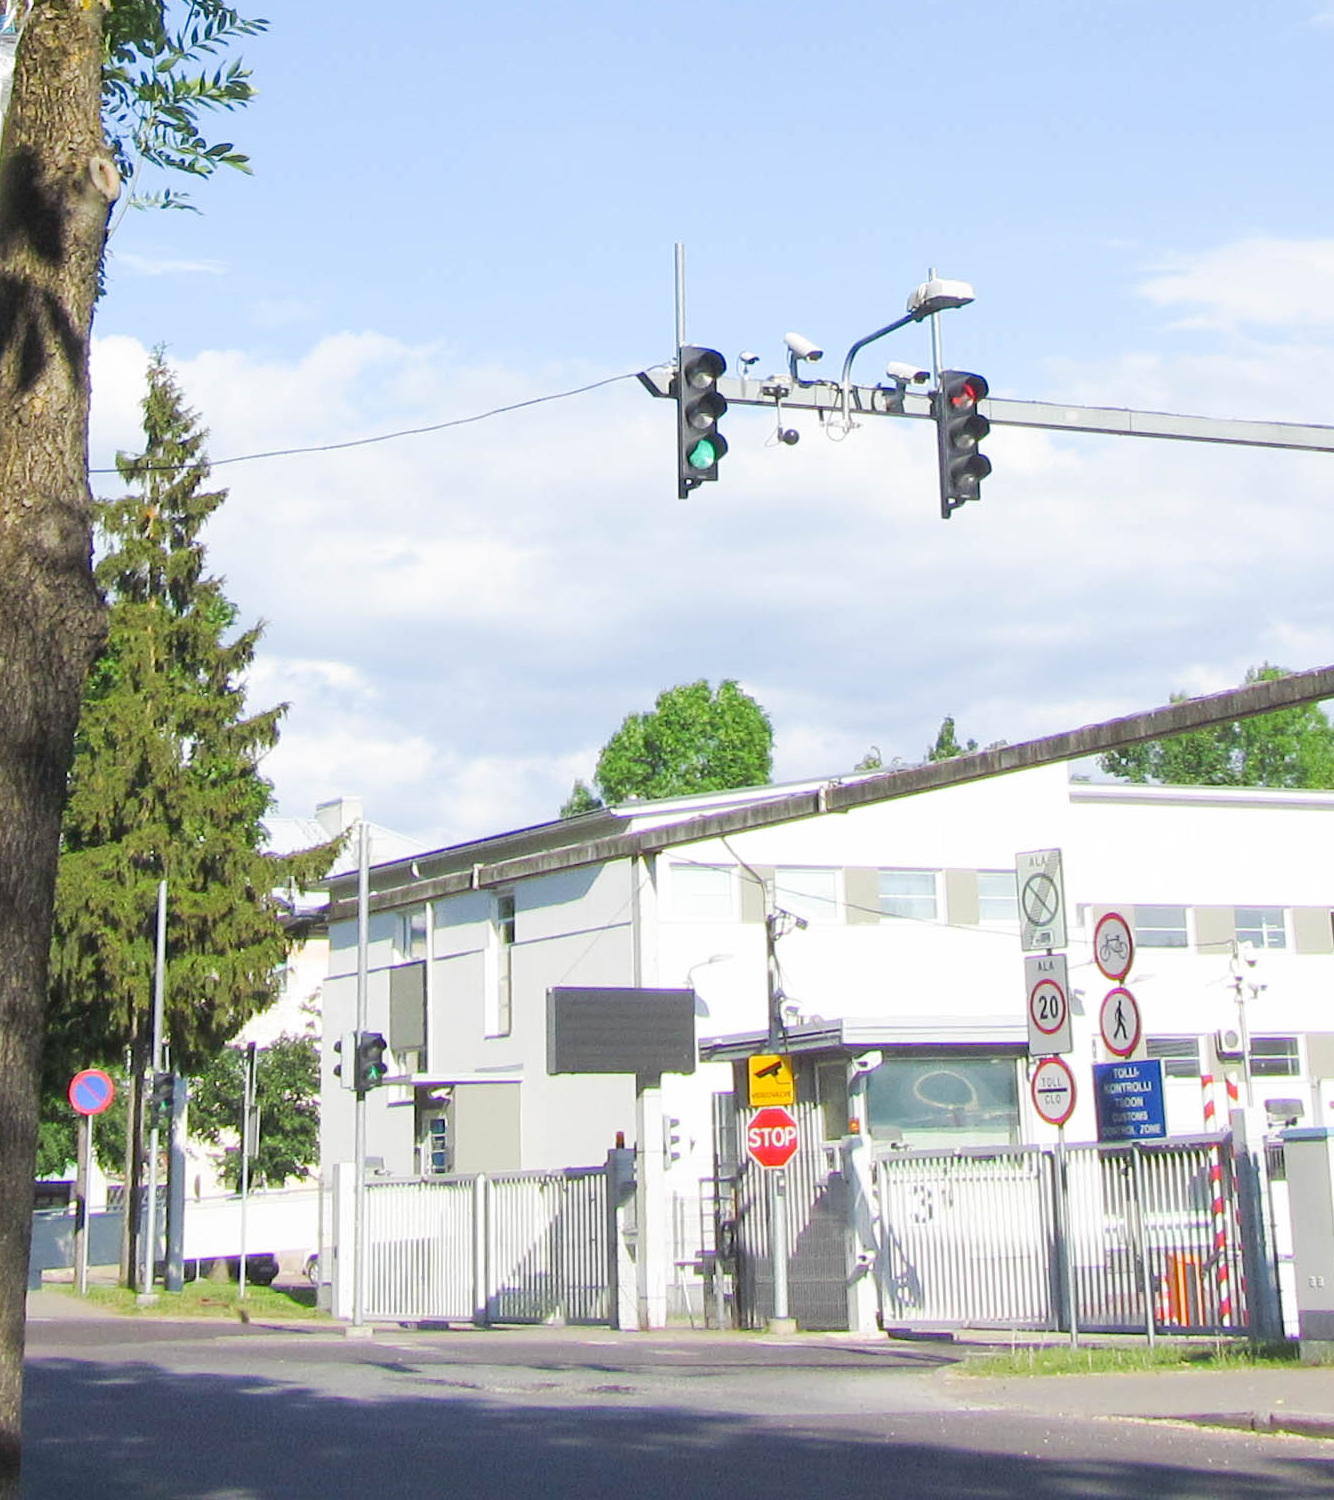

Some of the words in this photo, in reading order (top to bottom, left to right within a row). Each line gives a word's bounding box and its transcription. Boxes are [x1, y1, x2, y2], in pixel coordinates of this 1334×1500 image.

[1038, 961, 1055, 972] ALA
[1038, 995, 1059, 1020] 20
[1042, 1077, 1062, 1088] TOLL
[1103, 1081, 1153, 1094] KONTROLLI
[1111, 1111, 1149, 1122] CUSTOMS
[1139, 1123, 1162, 1135] ZONE
[748, 1125, 797, 1149] STOP
